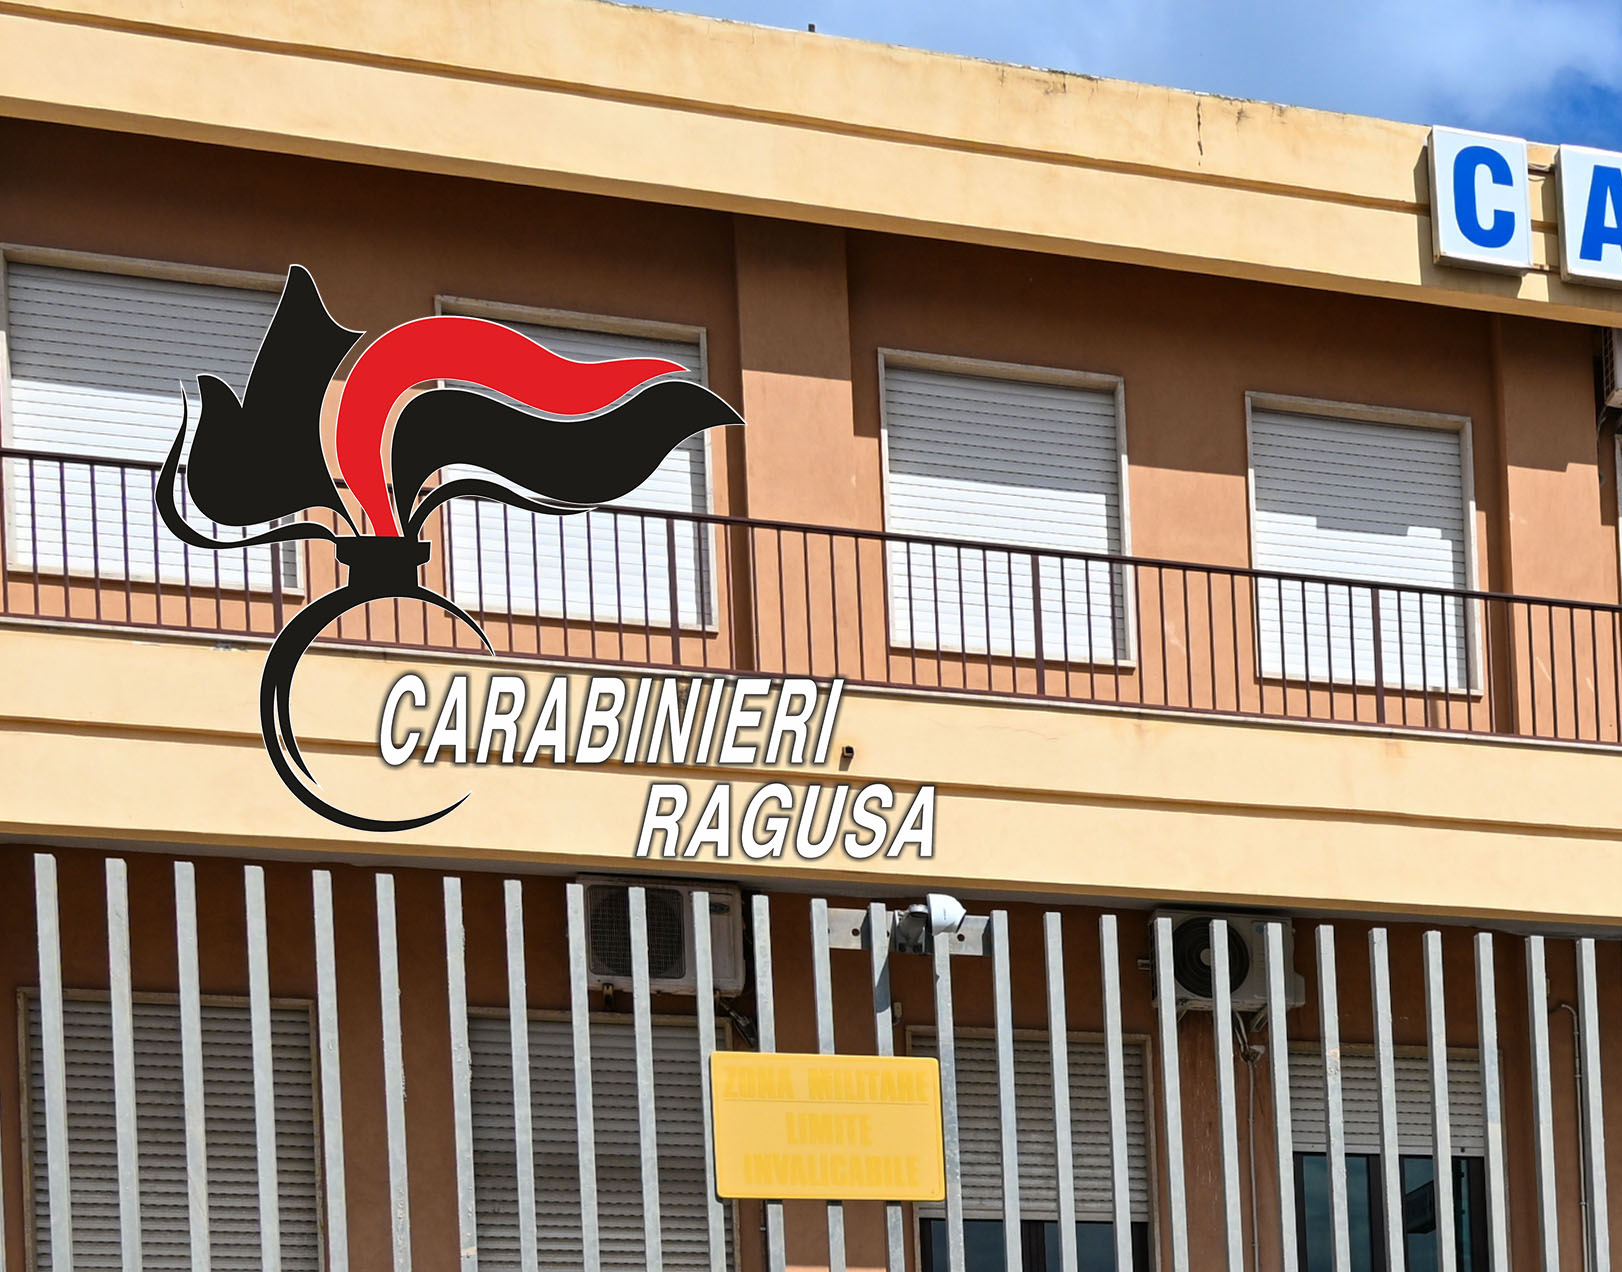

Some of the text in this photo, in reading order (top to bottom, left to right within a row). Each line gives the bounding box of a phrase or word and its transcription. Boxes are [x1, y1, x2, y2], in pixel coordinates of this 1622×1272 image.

[722, 1065, 929, 1102] ZONA MILITARE
[786, 1112, 873, 1146] LIMITE
[744, 1153, 921, 1188] INVALICABILE
